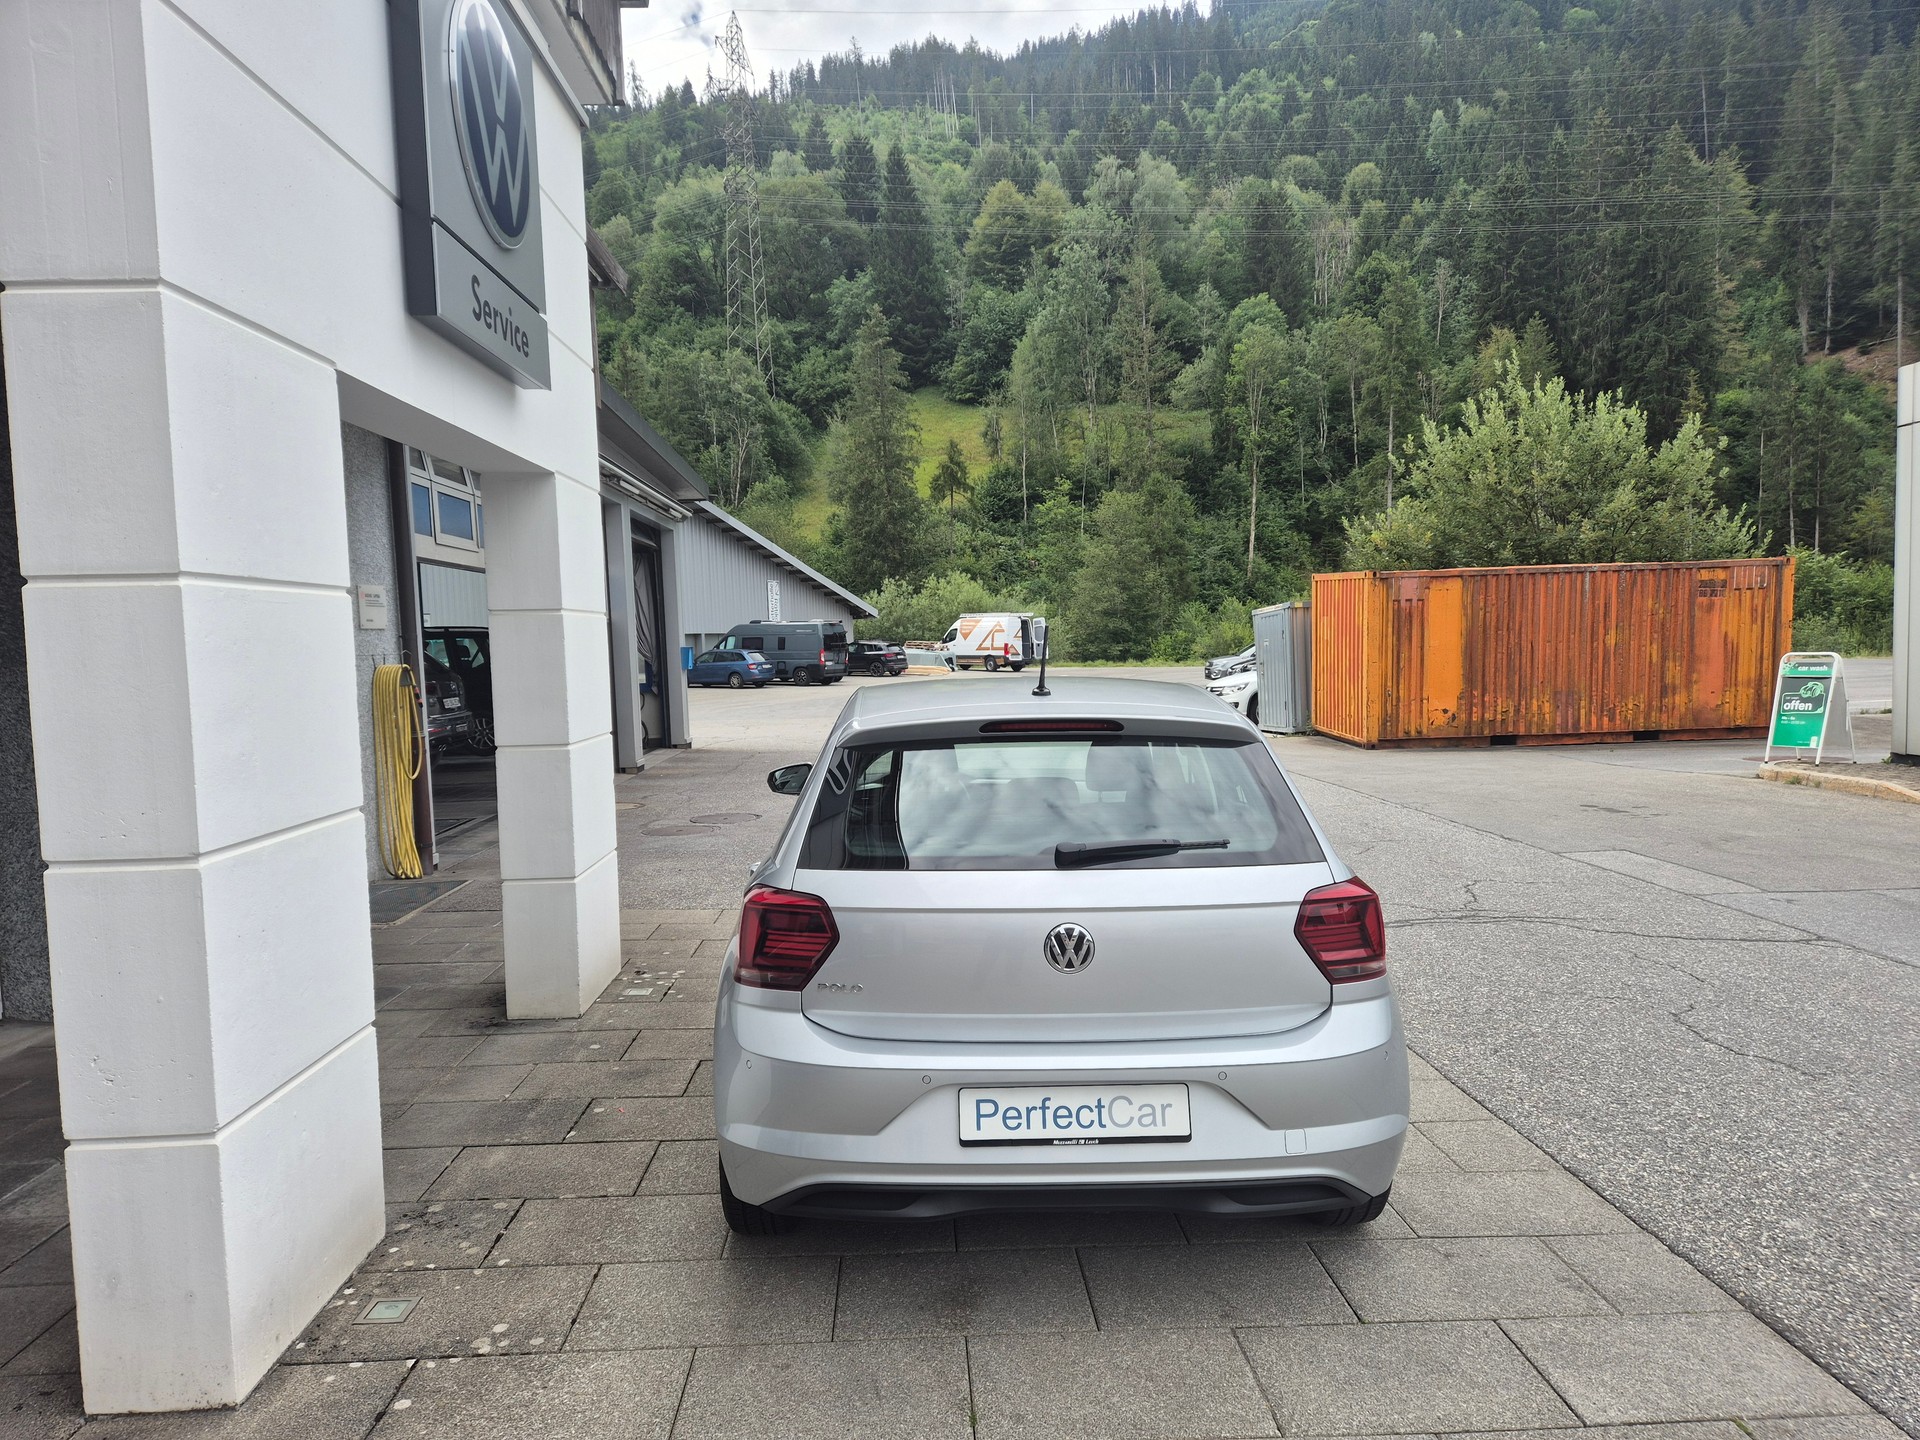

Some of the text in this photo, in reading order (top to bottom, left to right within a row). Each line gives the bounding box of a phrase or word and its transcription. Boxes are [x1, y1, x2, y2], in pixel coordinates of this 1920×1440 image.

[470, 274, 530, 359] Service
[1809, 664, 1828, 672] wash
[1783, 699, 1813, 711] offen
[1045, 924, 1094, 973] VW
[817, 982, 864, 994] POLO
[974, 1095, 1173, 1131] PerfectCar
